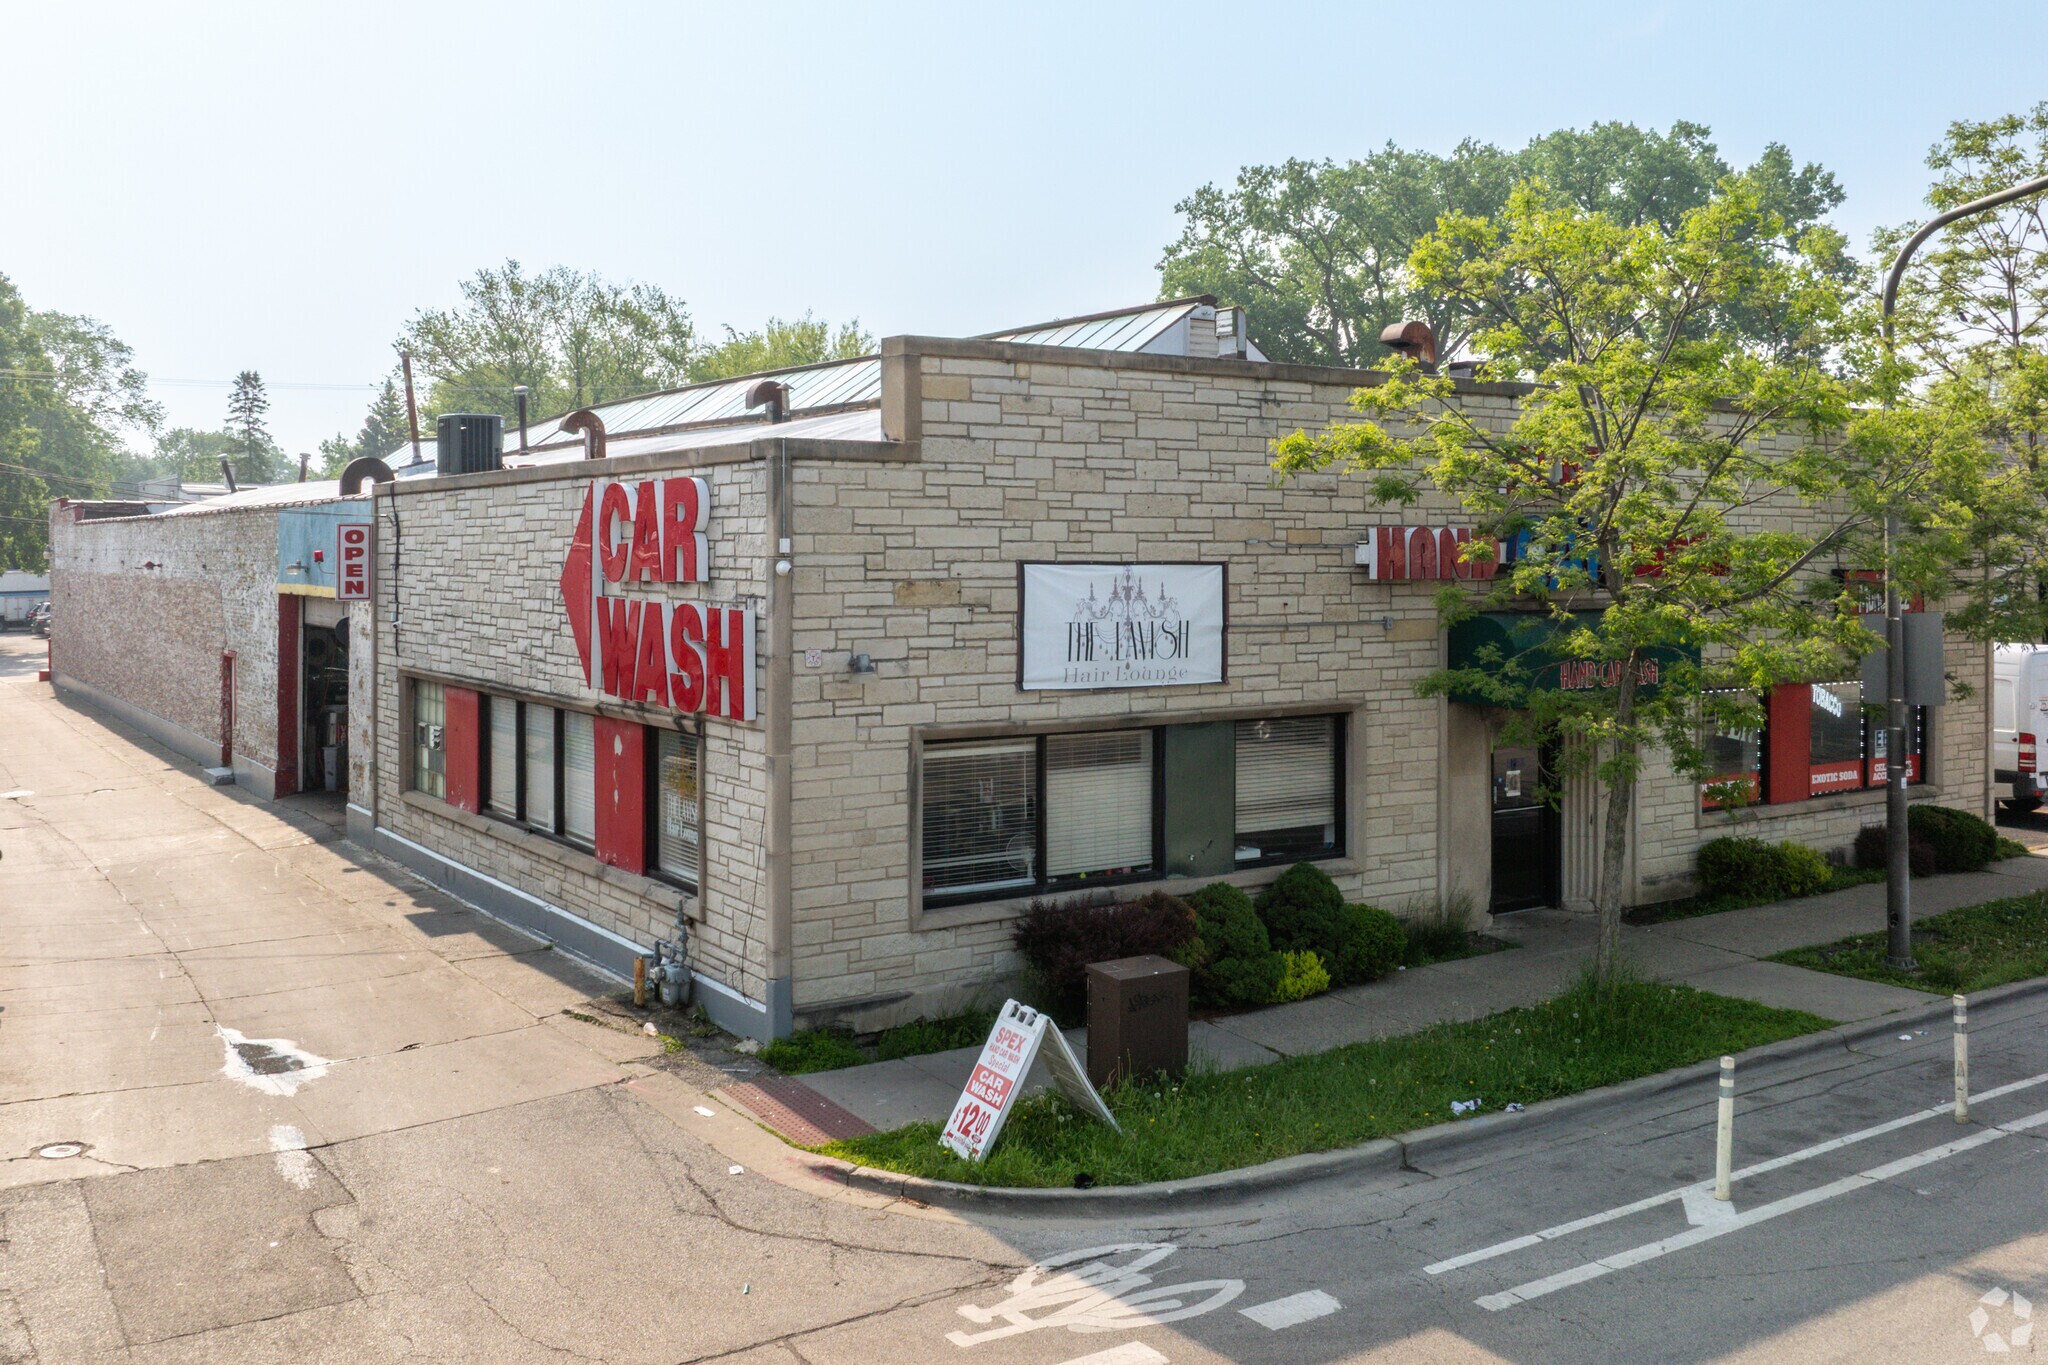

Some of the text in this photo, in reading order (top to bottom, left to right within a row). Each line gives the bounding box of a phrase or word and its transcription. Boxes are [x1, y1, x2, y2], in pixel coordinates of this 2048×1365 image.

[600, 477, 707, 583] CAR
[344, 529, 365, 595] OPEN
[1376, 527, 1501, 580] HAND
[1064, 619, 1190, 662] THE LAVISH
[596, 596, 748, 721] WASH
[1063, 665, 1189, 687] Hair Lounge
[1560, 660, 1596, 690] HAND
[1811, 684, 1842, 718] TOBACCO
[1811, 770, 1858, 785] EXOTIC SODA
[995, 1026, 1027, 1054] SPEX
[998, 1048, 1009, 1059] CAR
[987, 1054, 1010, 1073] Special
[970, 1080, 1004, 1106] WASH
[979, 1070, 1004, 1092] CAR
